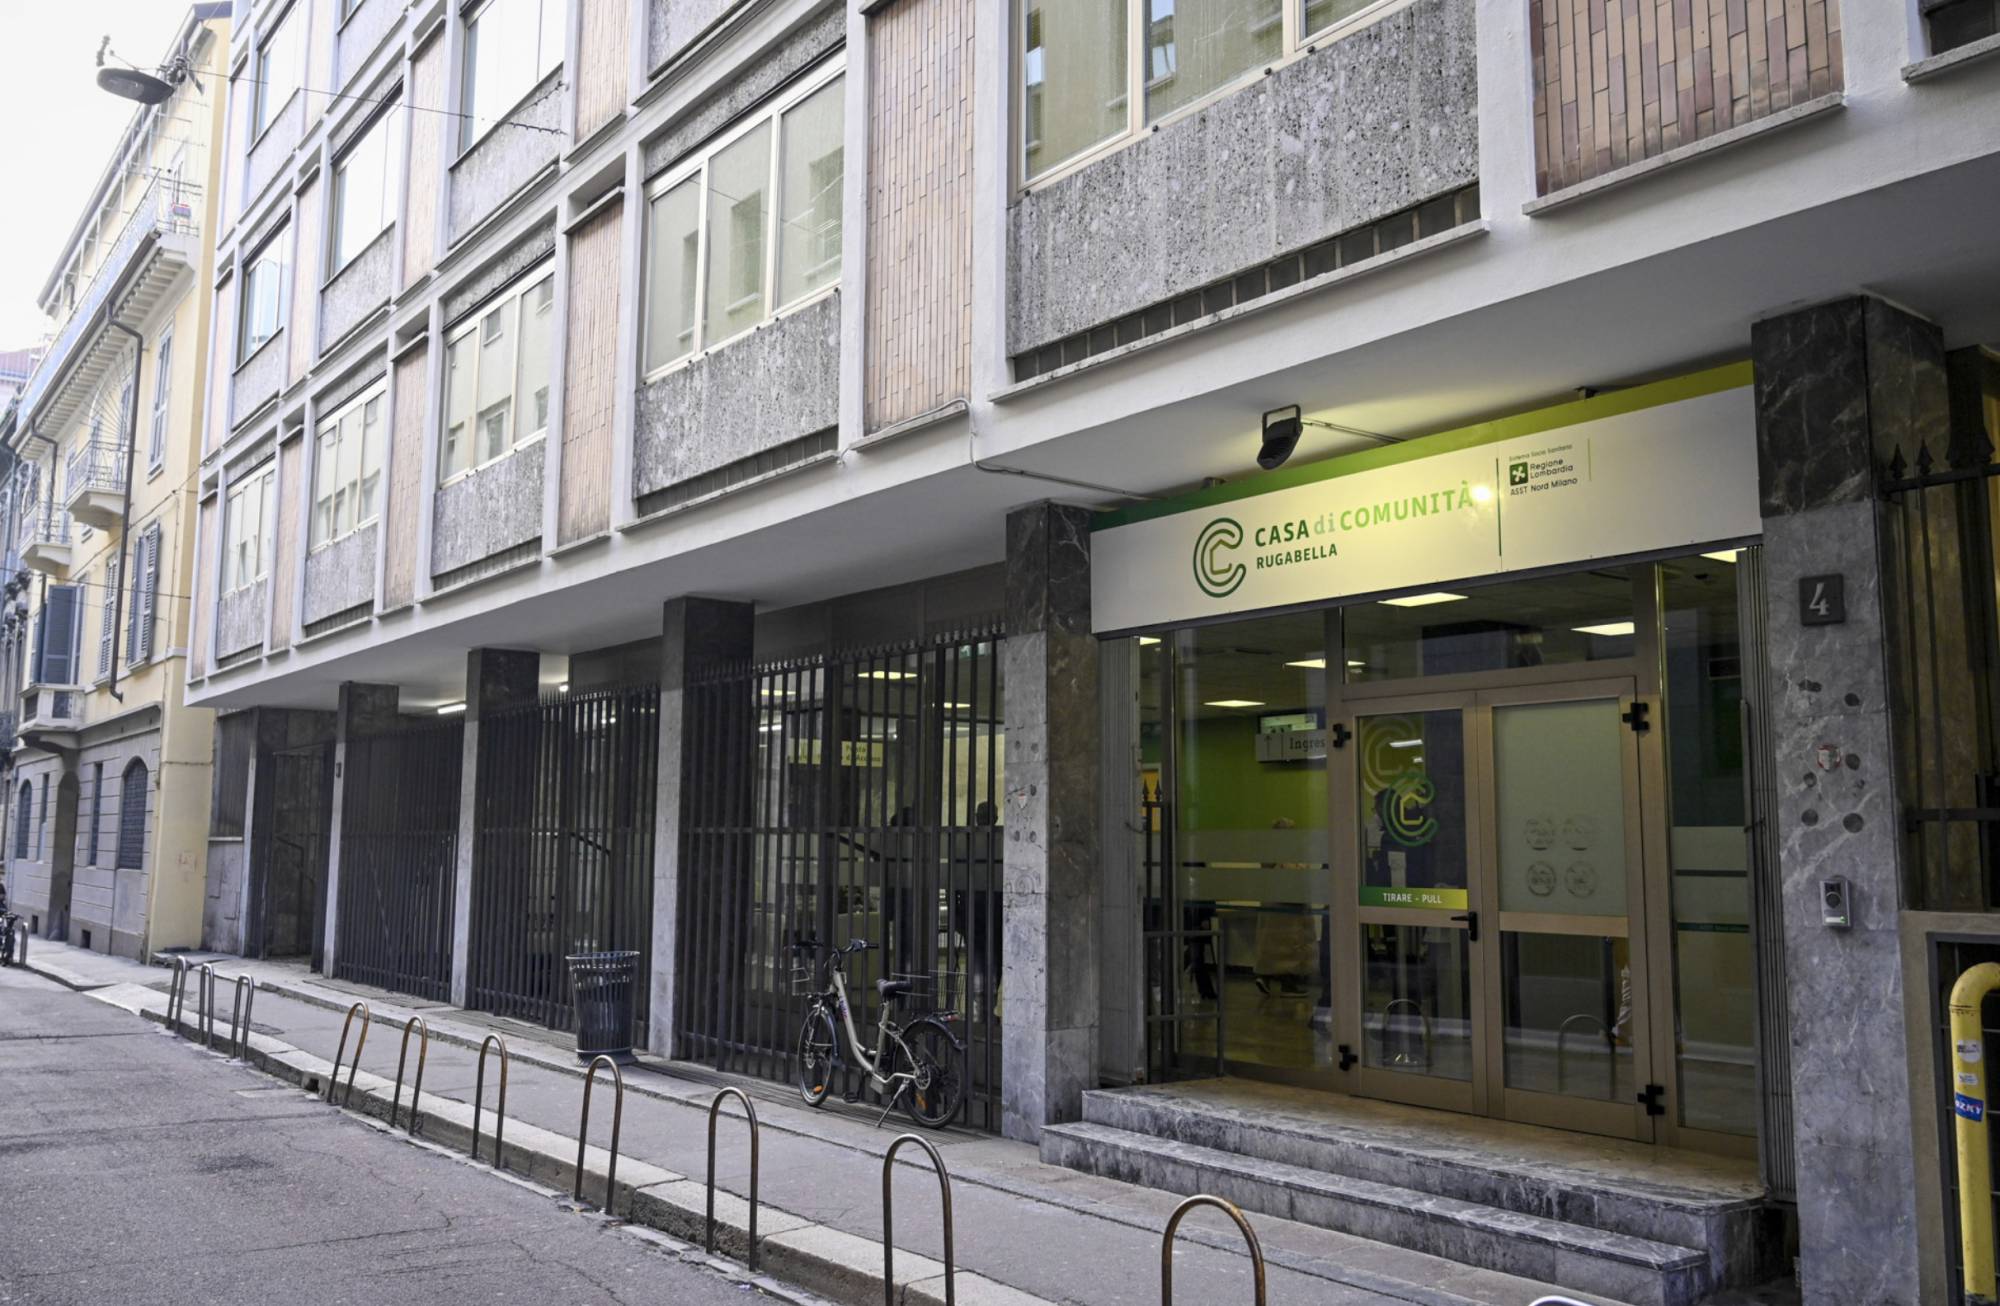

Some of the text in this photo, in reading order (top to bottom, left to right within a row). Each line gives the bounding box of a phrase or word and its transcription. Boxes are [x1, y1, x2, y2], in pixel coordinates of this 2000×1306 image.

[1530, 459, 1563, 471] Regione
[1530, 464, 1573, 479] Lombardia
[1510, 478, 1578, 496] ASST Nord Milano
[1255, 480, 1474, 547] CASA di COMUNITÀ
[1256, 543, 1338, 570] RUGABELLA
[1809, 582, 1829, 616] 4
[1383, 892, 1413, 903] TIRARE
[1421, 894, 1442, 904] PULL
